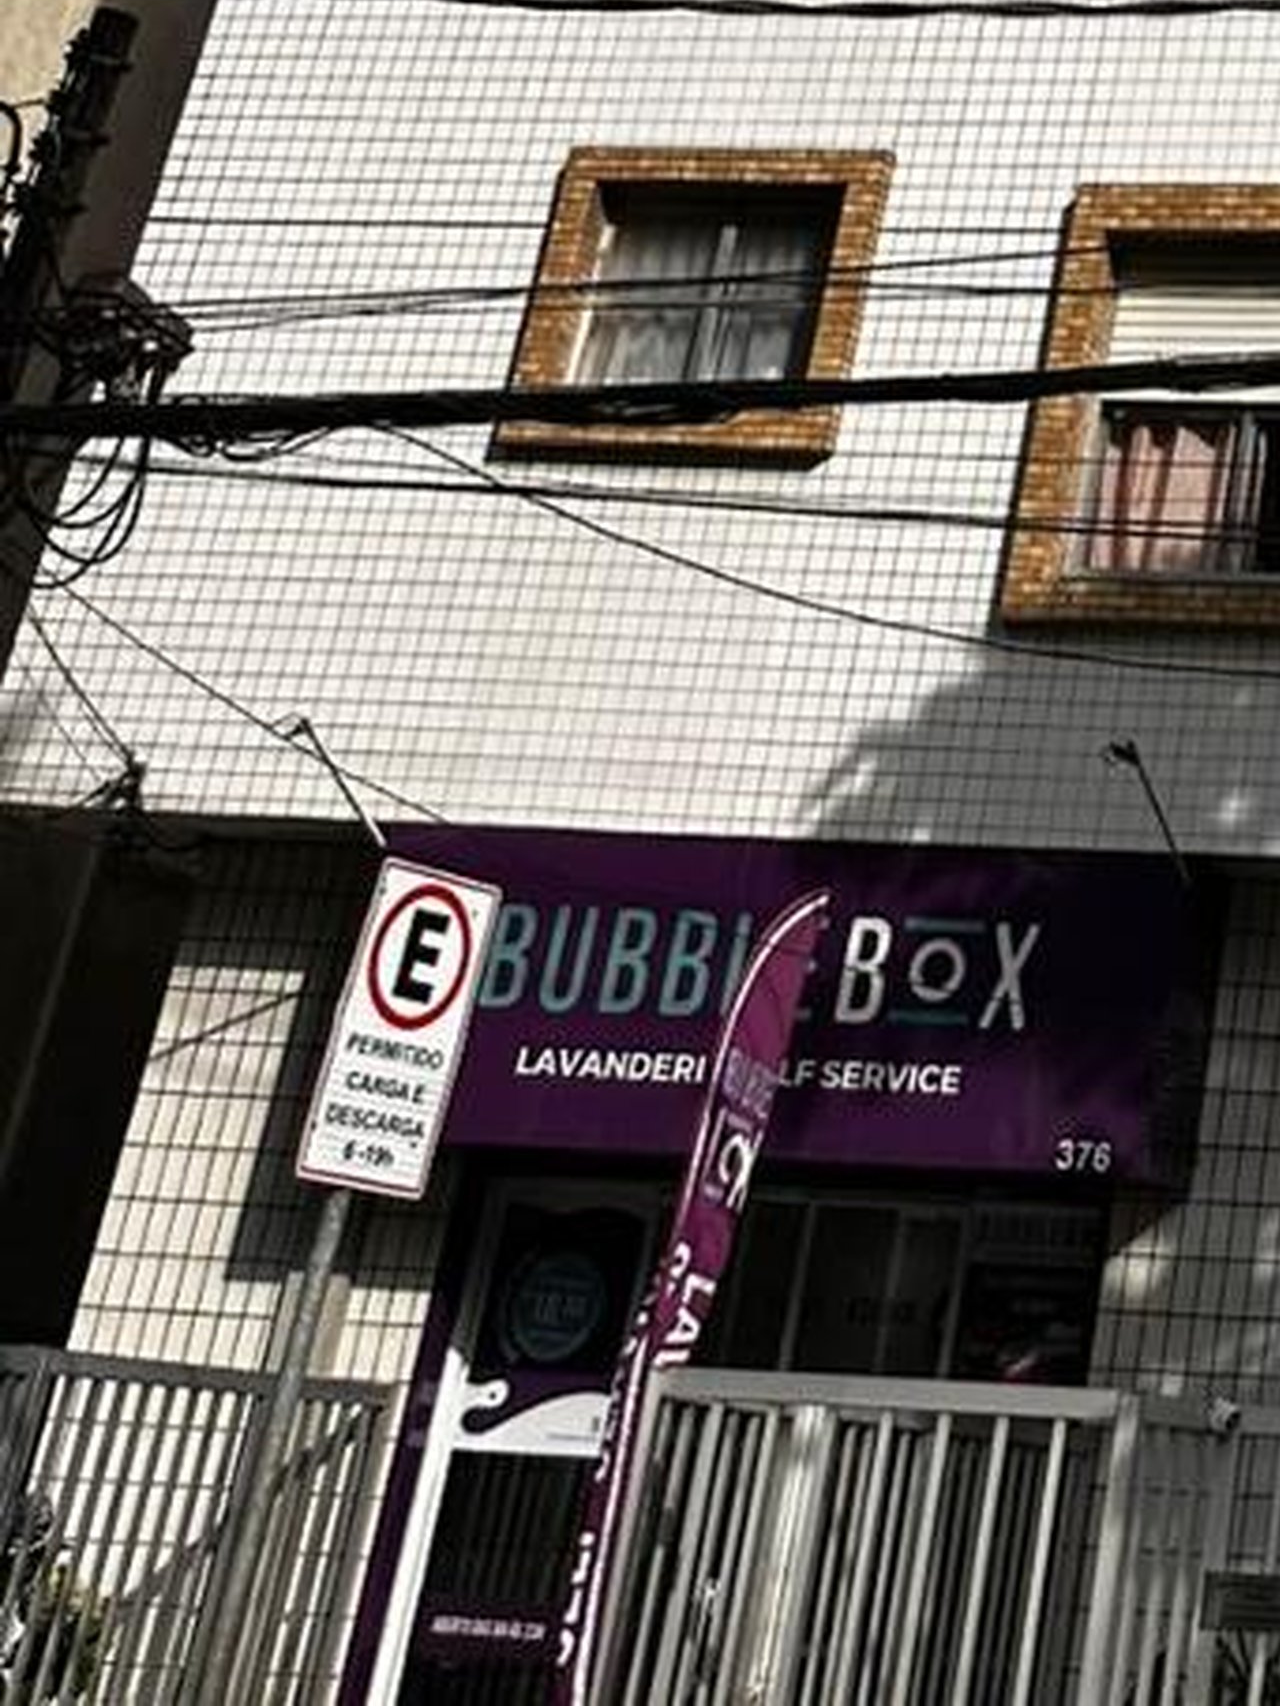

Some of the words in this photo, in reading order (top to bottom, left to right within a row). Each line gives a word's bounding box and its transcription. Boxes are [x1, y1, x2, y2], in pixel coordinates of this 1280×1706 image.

[391, 907, 451, 1004] E
[479, 902, 830, 1020] BUBBL
[834, 915, 1040, 1033] BOX
[346, 1032, 445, 1071] PERMITIDO
[515, 1046, 706, 1084] LAVANDERI
[820, 1059, 962, 1094] SERVICE
[345, 1071, 410, 1100] CARGA
[411, 1083, 426, 1105] E
[324, 1102, 425, 1139] DESCARGA
[1055, 1139, 1112, 1174] 376
